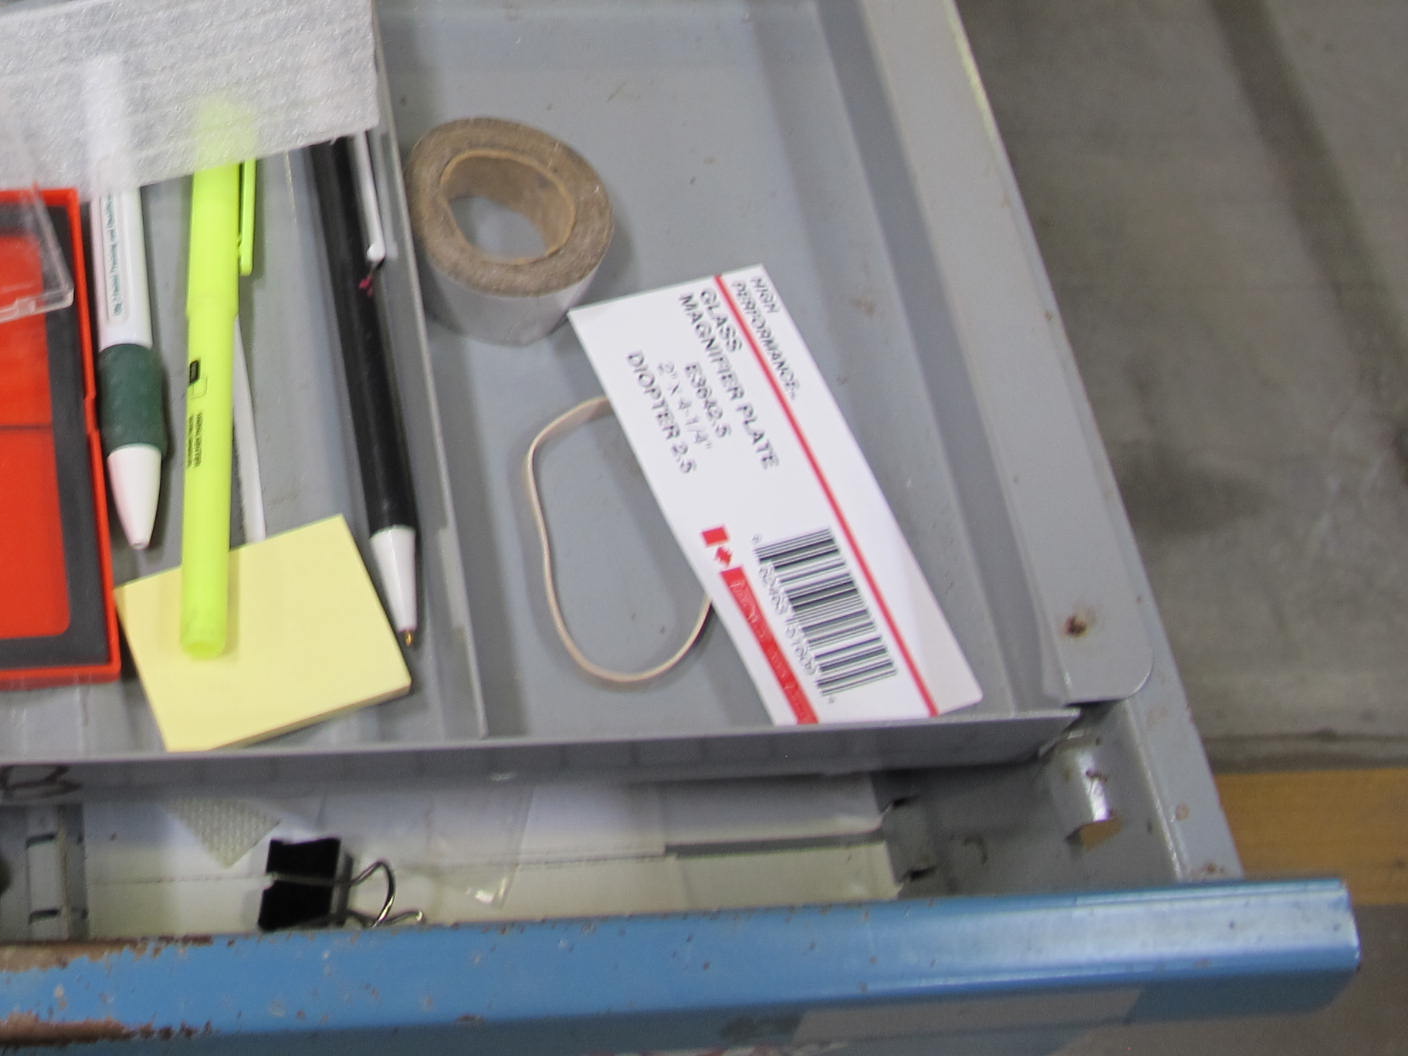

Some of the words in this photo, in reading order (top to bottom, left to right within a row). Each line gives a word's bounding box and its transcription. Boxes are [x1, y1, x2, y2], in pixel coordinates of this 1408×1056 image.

[679, 293, 744, 400] MAGNIFIER
[736, 404, 778, 469] PLATE
[700, 288, 742, 352] GLASS
[627, 351, 680, 440] DIOPTER
[671, 442, 696, 473] 2.5
